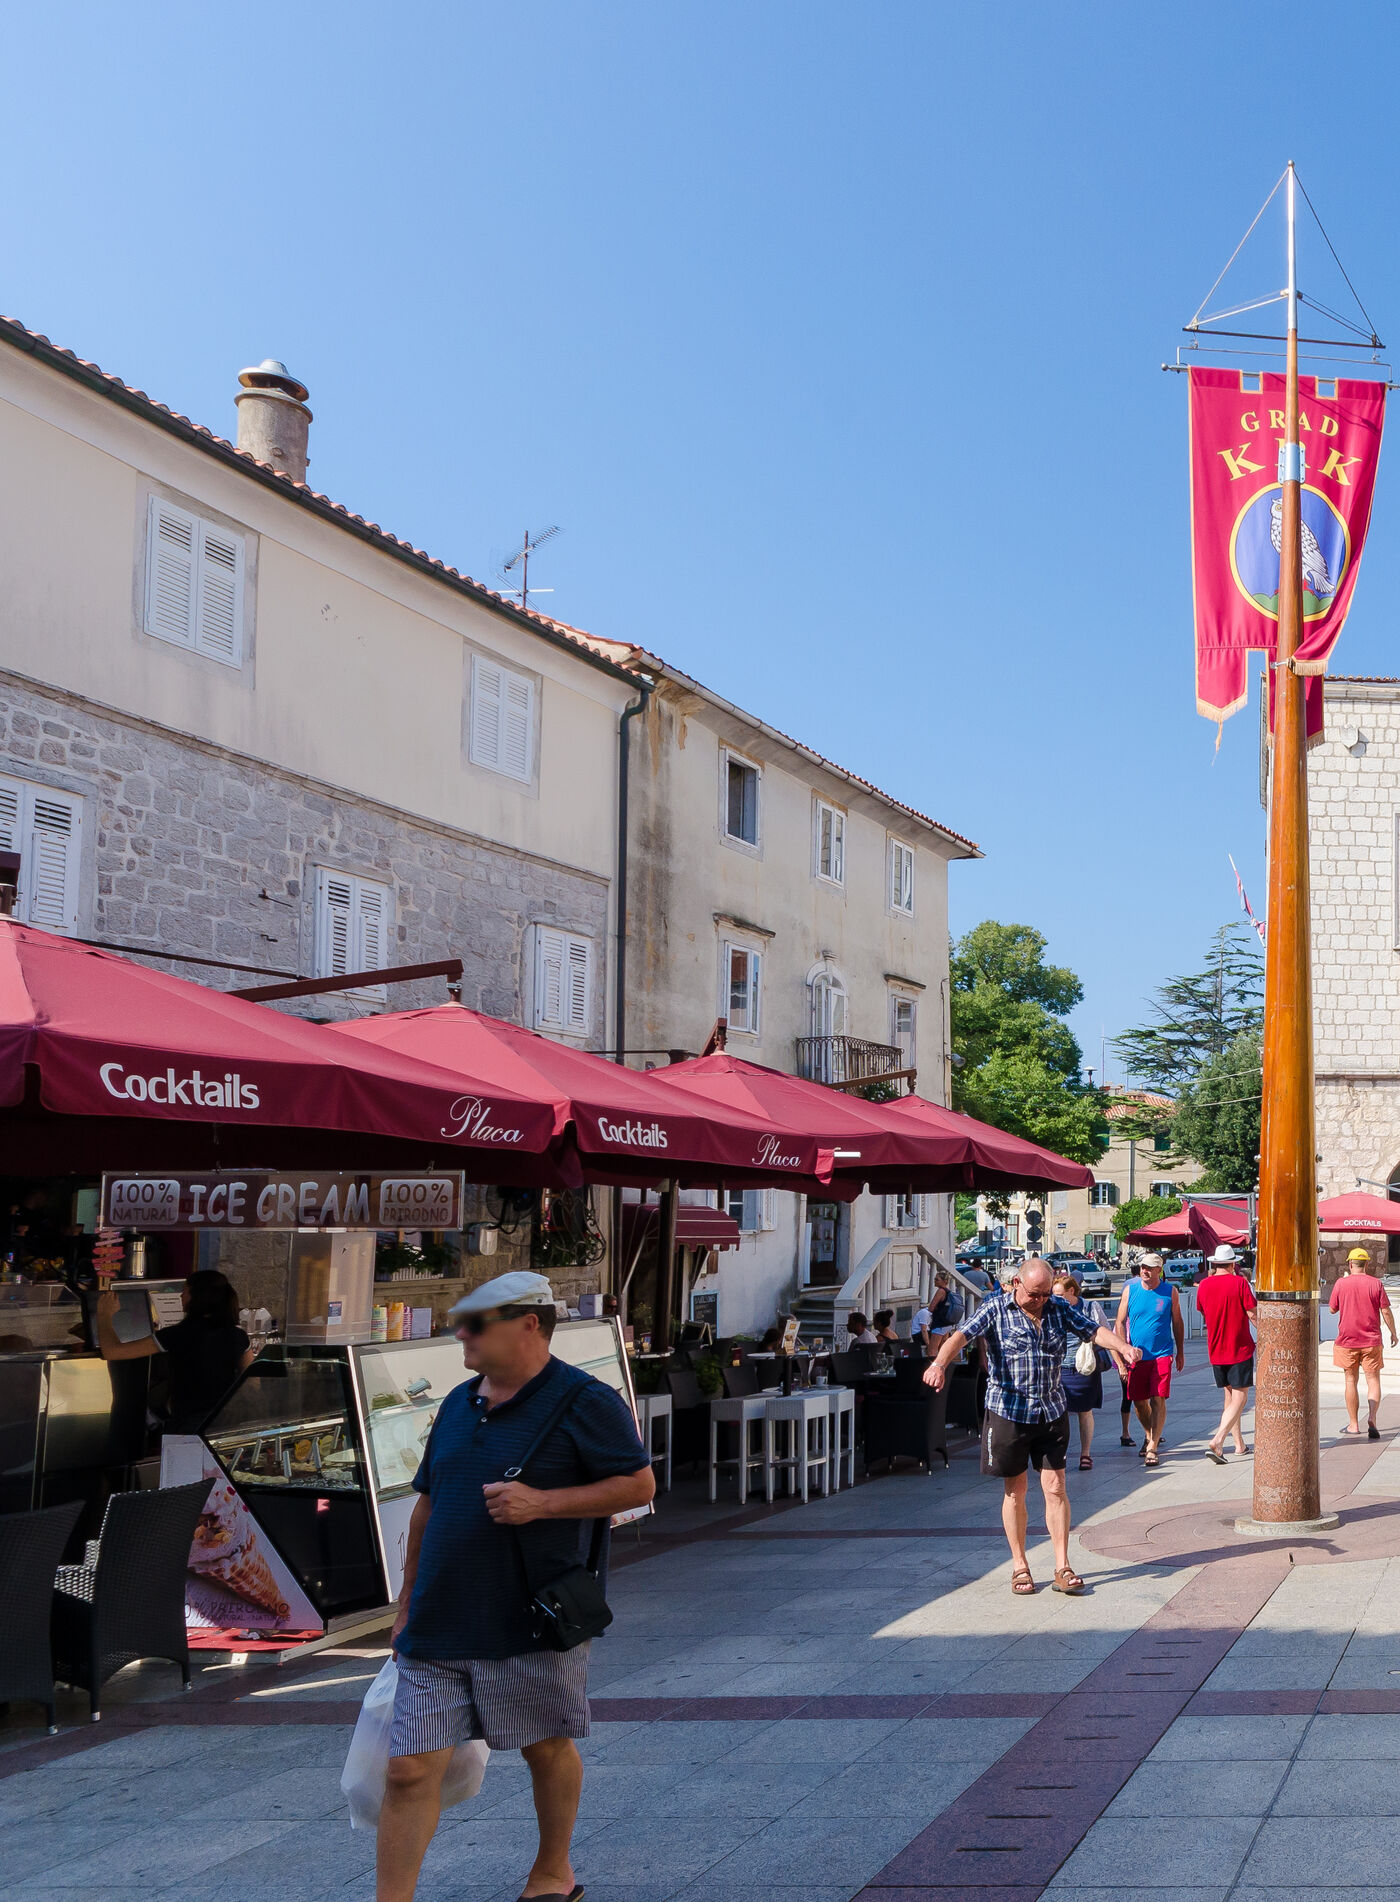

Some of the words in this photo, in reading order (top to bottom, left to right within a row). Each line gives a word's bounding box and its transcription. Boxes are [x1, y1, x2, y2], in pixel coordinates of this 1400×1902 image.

[1240, 409, 1339, 437] GRAD
[1216, 437, 1363, 486] KK
[99, 1062, 260, 1109] Cocktails
[440, 1095, 525, 1143] Placa
[598, 1117, 668, 1148] Cocktails
[751, 1133, 802, 1167] Placa
[116, 1183, 174, 1203] 100%
[188, 1181, 248, 1224] ICE
[256, 1181, 370, 1225] CREAM
[385, 1183, 449, 1203] 100%
[112, 1207, 176, 1221] NATURAL
[382, 1207, 449, 1222] PRIRODNO
[1343, 1219, 1382, 1227] COCKTAILS
